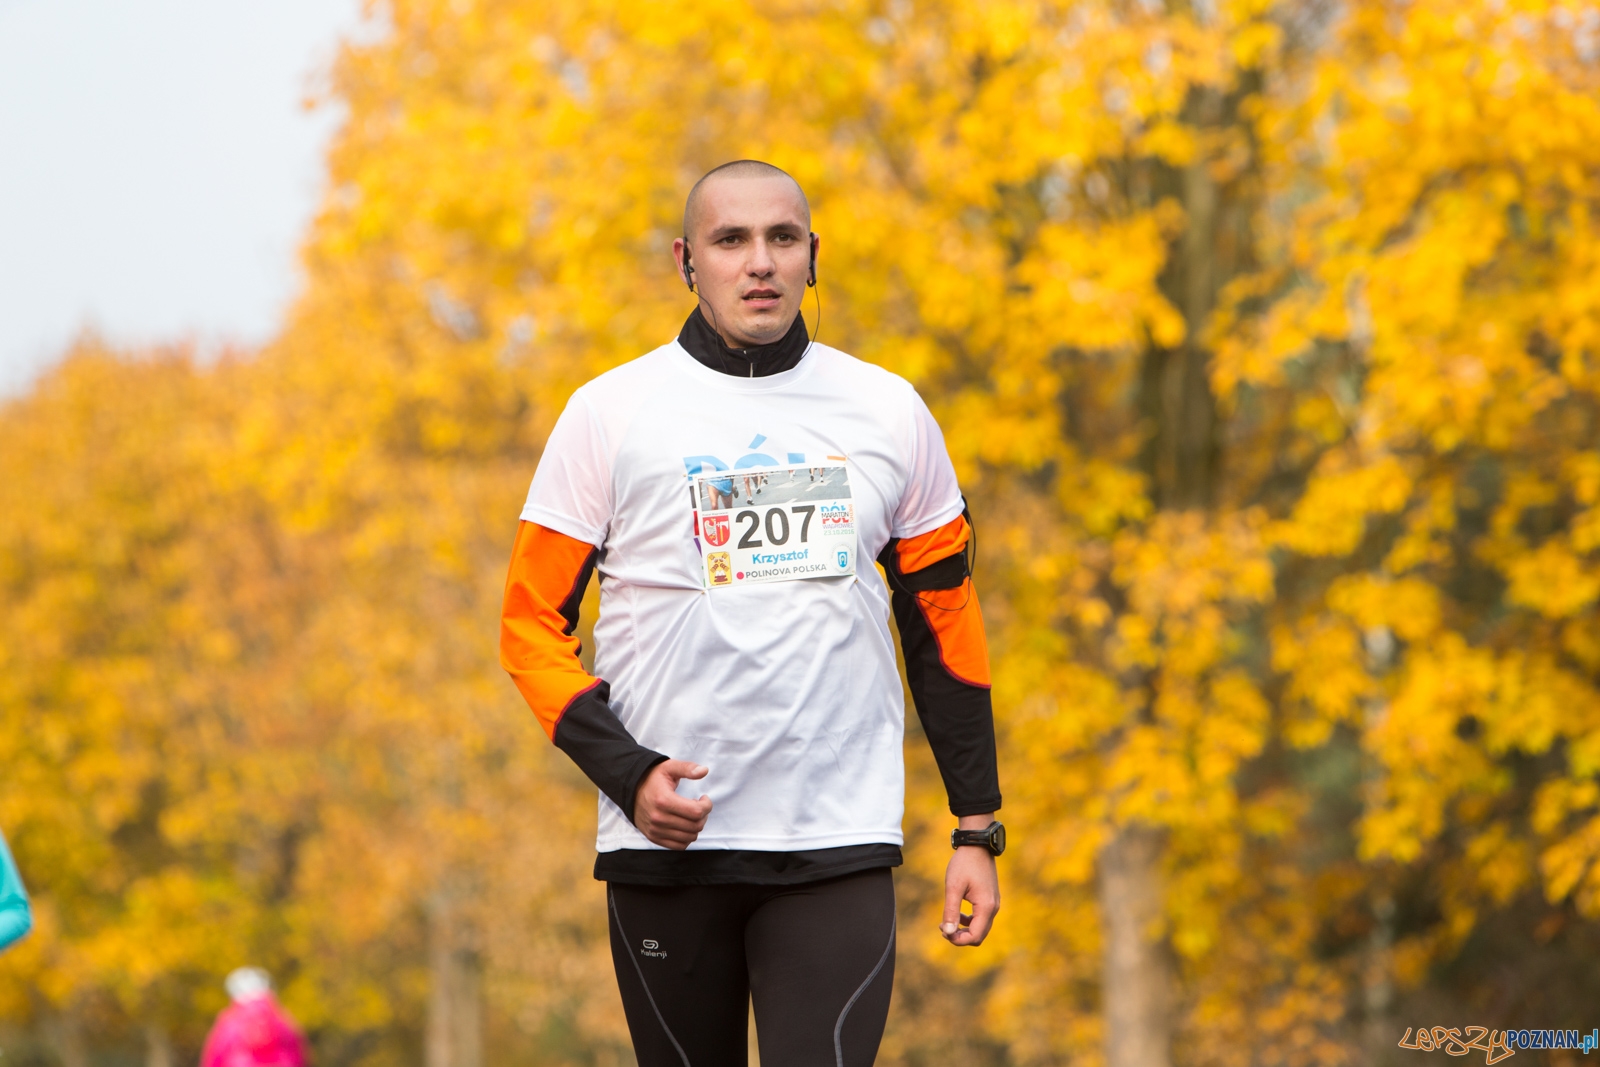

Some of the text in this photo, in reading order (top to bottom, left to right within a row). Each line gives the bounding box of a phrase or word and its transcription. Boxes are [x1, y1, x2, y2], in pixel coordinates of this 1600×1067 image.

[735, 505, 816, 550] 207
[752, 549, 809, 565] Krzysztof
[746, 564, 826, 578] POLINOVA POLSKA
